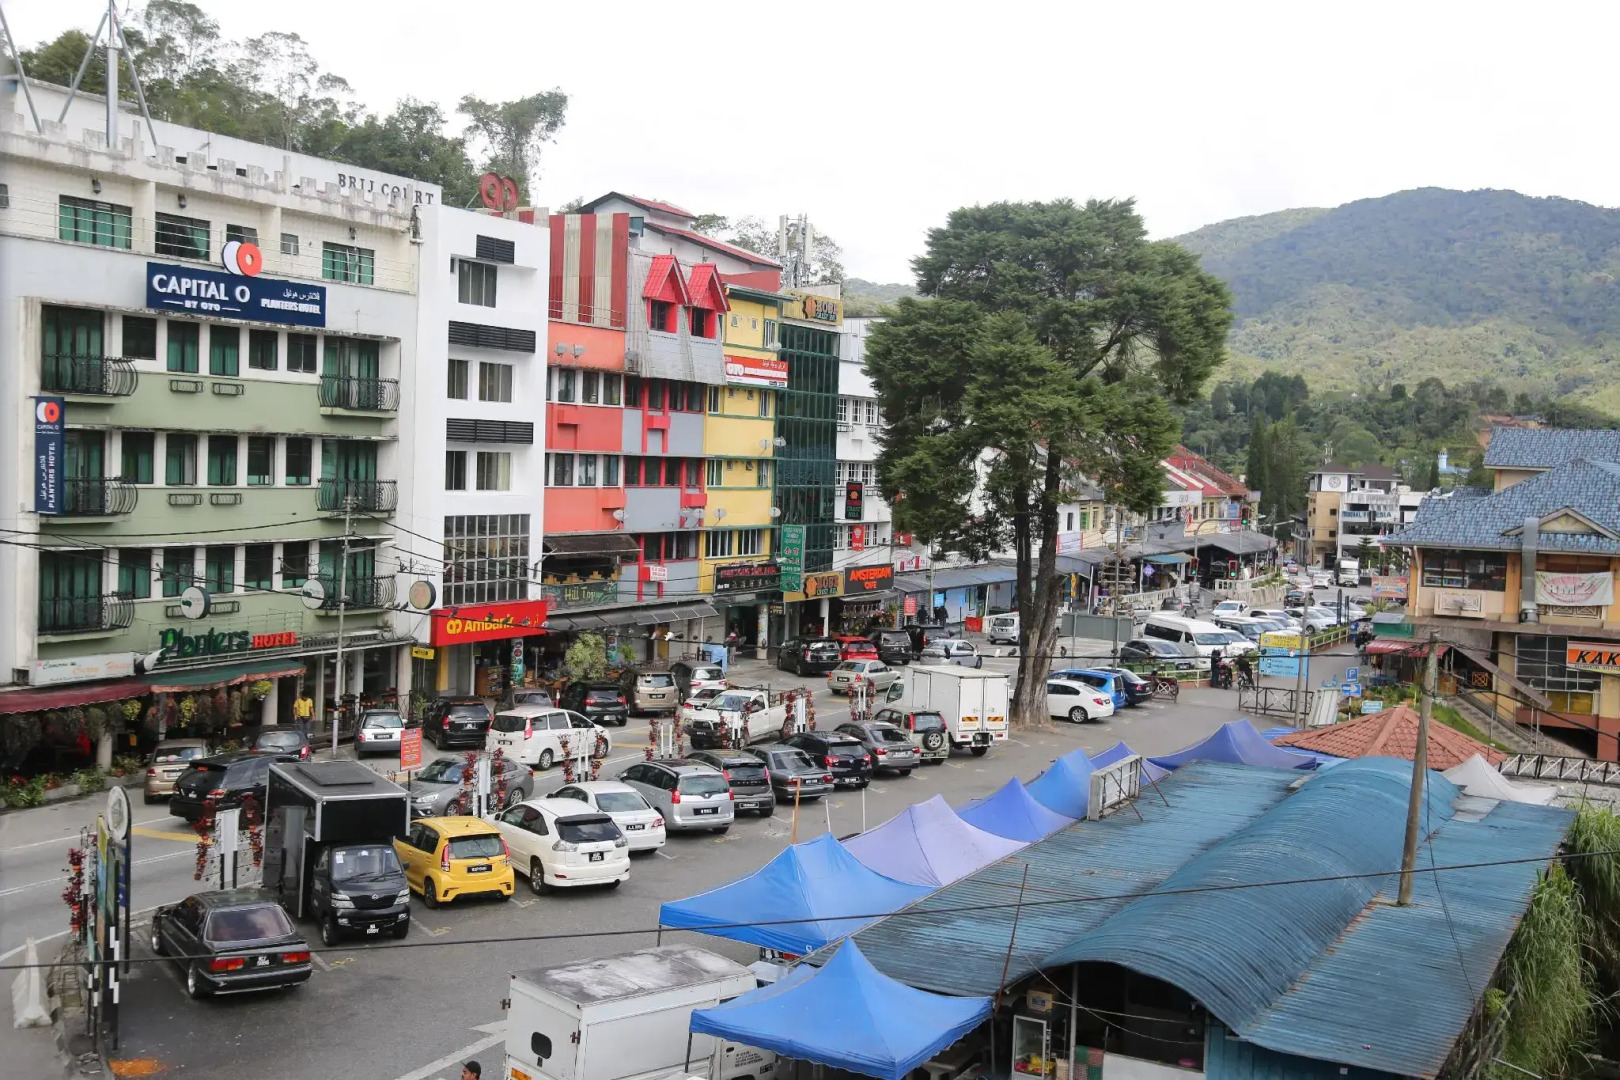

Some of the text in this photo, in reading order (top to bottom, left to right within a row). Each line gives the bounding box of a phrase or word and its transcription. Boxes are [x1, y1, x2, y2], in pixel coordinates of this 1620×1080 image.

[338, 173, 374, 194] BRIJ
[152, 274, 250, 303] CAPITAL O
[184, 299, 221, 312] BY OYO
[260, 298, 321, 315] PLANTERS HOTEL
[564, 587, 579, 600] Hill
[158, 626, 297, 662] Planters HOTEL
[1349, 669, 1356, 677] P
